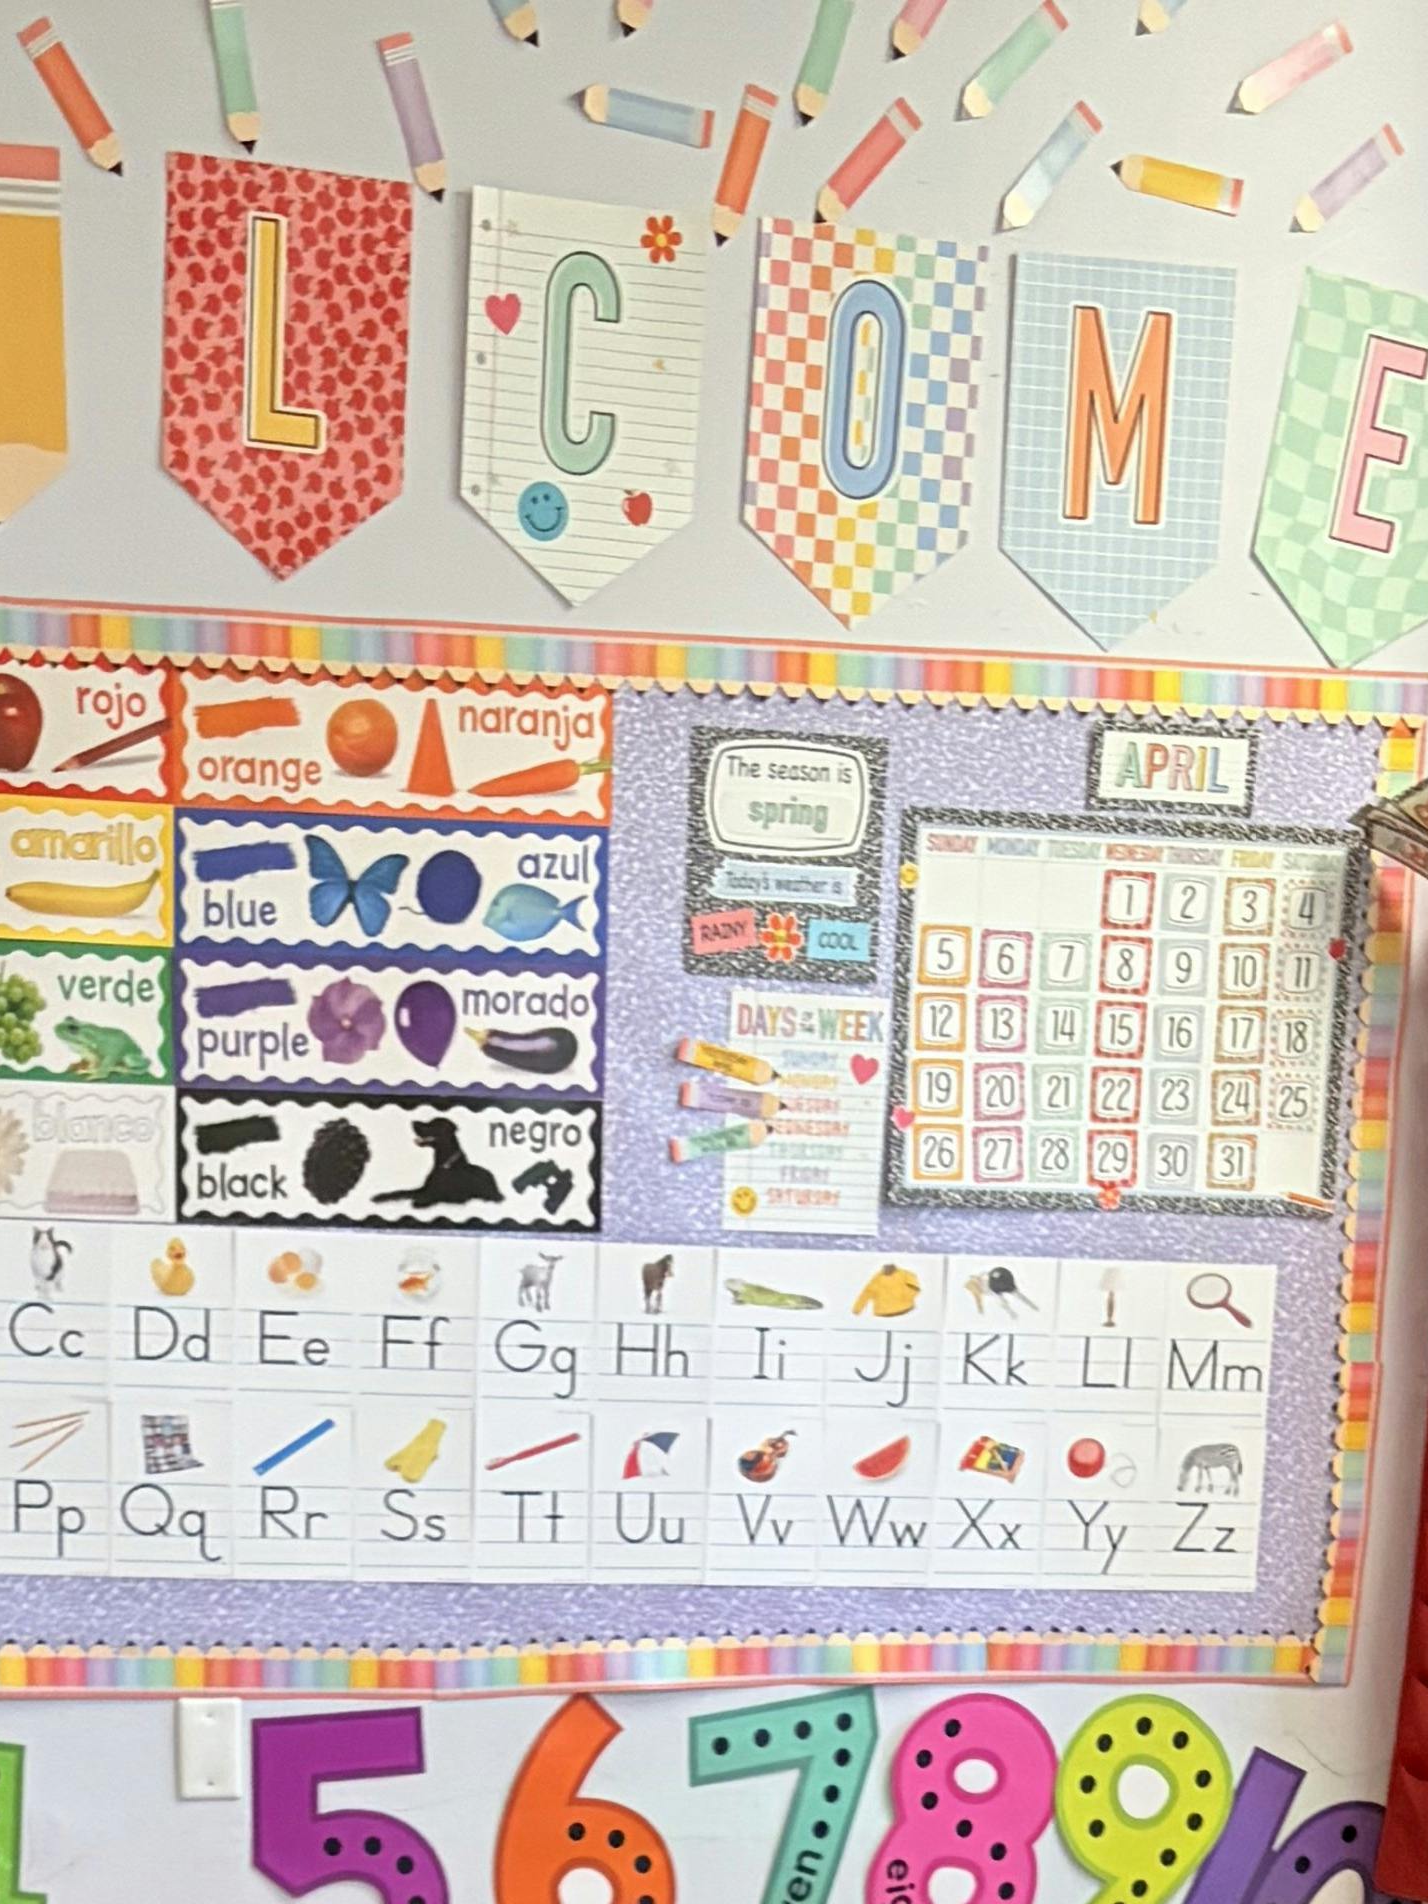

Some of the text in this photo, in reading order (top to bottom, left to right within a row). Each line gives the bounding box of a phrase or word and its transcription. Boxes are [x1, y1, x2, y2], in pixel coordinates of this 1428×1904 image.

[76, 682, 148, 731] rojo
[458, 704, 596, 752] naranja
[197, 754, 323, 793] orange
[727, 754, 852, 785] The season is
[1115, 740, 1230, 794] APRIL
[747, 795, 830, 834] spring
[10, 822, 158, 866] amarillo
[517, 843, 590, 884] azul
[203, 889, 278, 928] blue
[1124, 884, 1316, 926] 1 2 3 4
[700, 920, 748, 942] RAINY
[818, 929, 859, 951] COOL
[937, 937, 1312, 990] 5 6 7 8 9 10 11
[57, 968, 156, 1006] verde
[462, 984, 590, 1020] morado
[737, 1003, 884, 1042] DAYS WEEK
[929, 1003, 1309, 1054] 12 13 14 15 16 17 18
[197, 1022, 310, 1071] purple
[926, 1070, 1309, 1119] 19 20 21 22 23 24 25
[31, 1102, 157, 1145] blanco
[488, 1117, 582, 1152] negro
[923, 1136, 1245, 1179] 26 27 28 29 30 31
[197, 1162, 289, 1201] black
[9, 1302, 85, 1358] Cc
[134, 1306, 210, 1362] Dd
[258, 1311, 330, 1365] Ee
[381, 1315, 450, 1370] Ff
[495, 1320, 577, 1400] Gg
[616, 1323, 689, 1378] Hh
[752, 1327, 787, 1380] Ii
[854, 1330, 913, 1408] Jj
[963, 1333, 1028, 1387] Kk
[1082, 1337, 1132, 1388] Ll
[1167, 1340, 1262, 1392] Mm
[14, 1480, 85, 1558] Pp
[120, 1484, 222, 1562] Qq
[259, 1486, 328, 1538] Rr
[381, 1489, 446, 1541] Ss
[501, 1491, 565, 1543] Tt
[616, 1492, 685, 1544] Uu
[737, 1493, 793, 1545] Vv
[826, 1496, 928, 1549] Ww
[951, 1498, 1021, 1550] Xx
[1066, 1500, 1128, 1575] Yy
[1173, 1502, 1237, 1552] Zz
